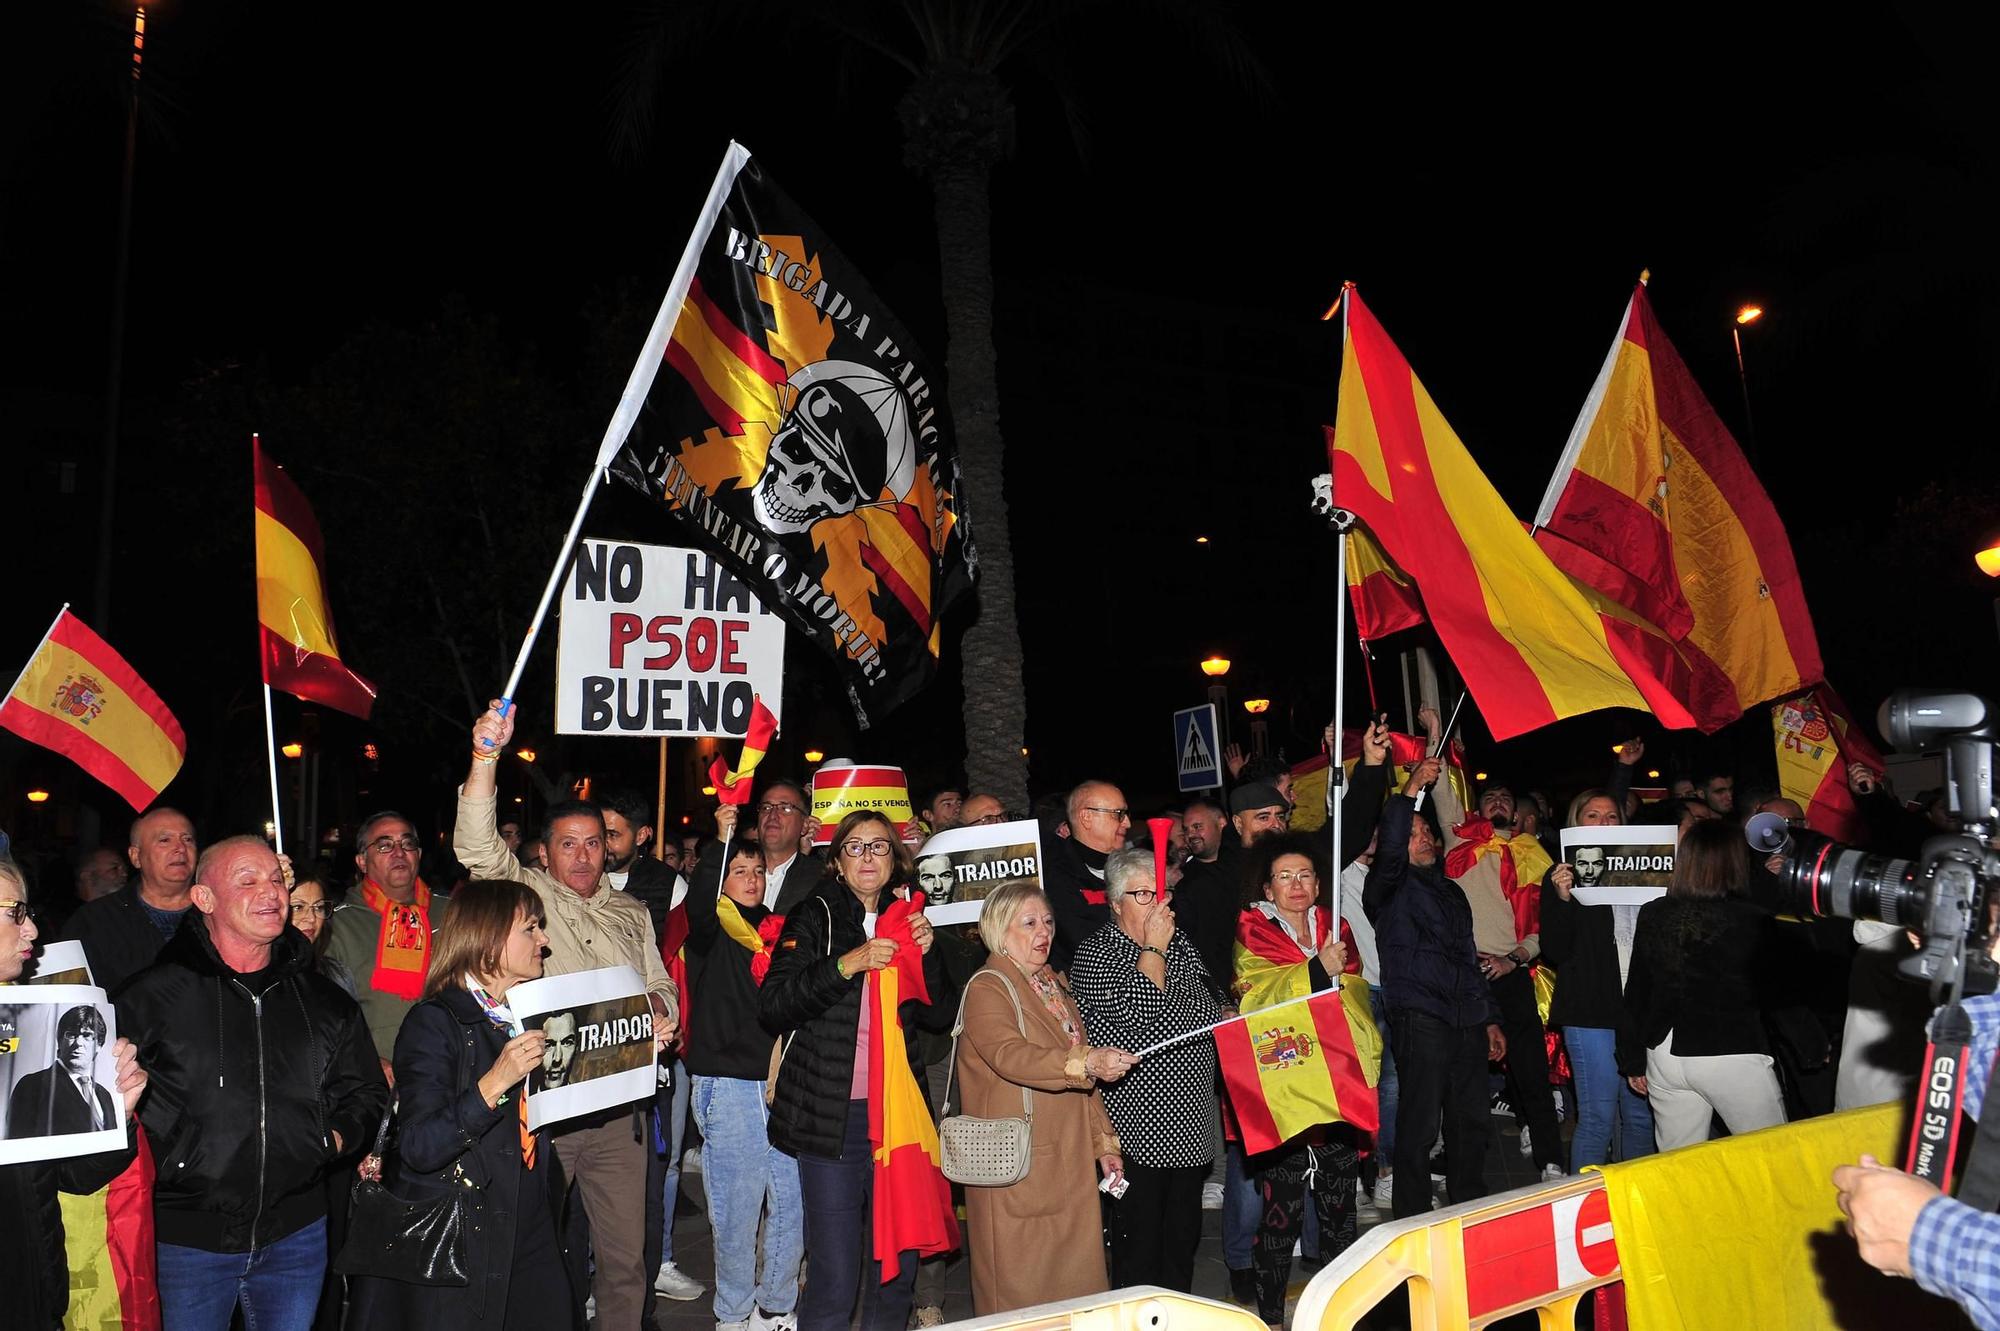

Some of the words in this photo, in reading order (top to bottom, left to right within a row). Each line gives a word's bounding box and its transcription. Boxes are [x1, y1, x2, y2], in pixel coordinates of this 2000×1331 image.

[725, 227, 870, 341] BRIGADA
[575, 543, 643, 603] NO
[684, 553, 771, 615] HA
[763, 553, 787, 580] O
[786, 572, 887, 686] MORIR!
[609, 612, 750, 675] PSOE
[581, 675, 754, 735] BUENO
[815, 798, 853, 809] ESPÑA
[855, 800, 870, 808] NO
[885, 799, 910, 807] VENDE
[955, 857, 1036, 883] TRAIDOR
[1606, 855, 1673, 871] TRAIDOR
[578, 1013, 653, 1052] TRAIDOR
[1929, 1057, 1955, 1109] EOS
[1923, 1113, 1947, 1141] 5D
[1915, 1142, 1935, 1177] Mark
